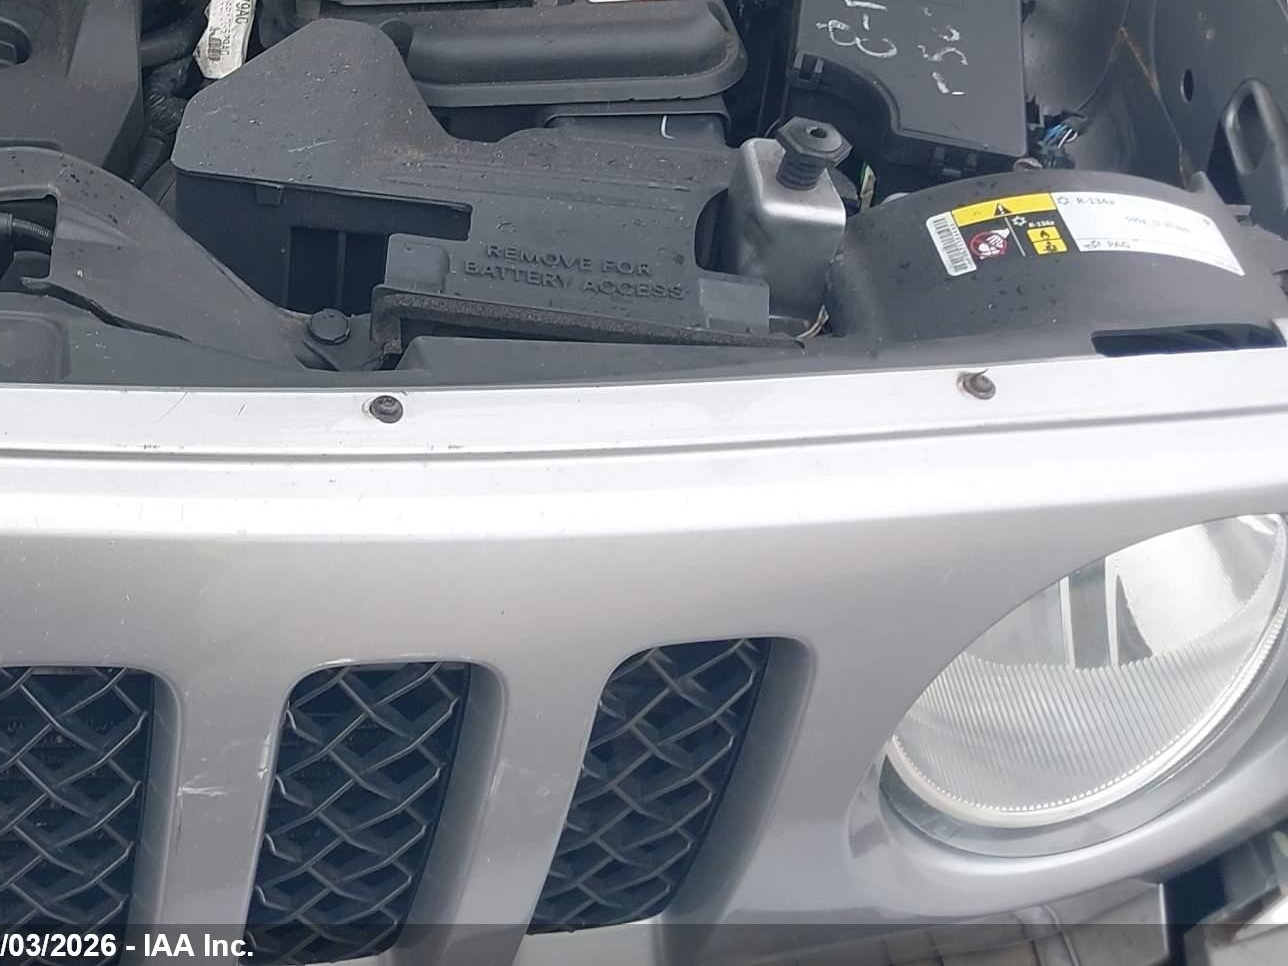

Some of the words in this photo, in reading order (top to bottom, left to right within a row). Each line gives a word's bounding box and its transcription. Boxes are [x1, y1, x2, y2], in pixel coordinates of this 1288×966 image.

[486, 244, 592, 272] REMOVE
[602, 259, 652, 276] FOR
[465, 260, 572, 289] BATTERY
[582, 278, 686, 300] ACCESS
